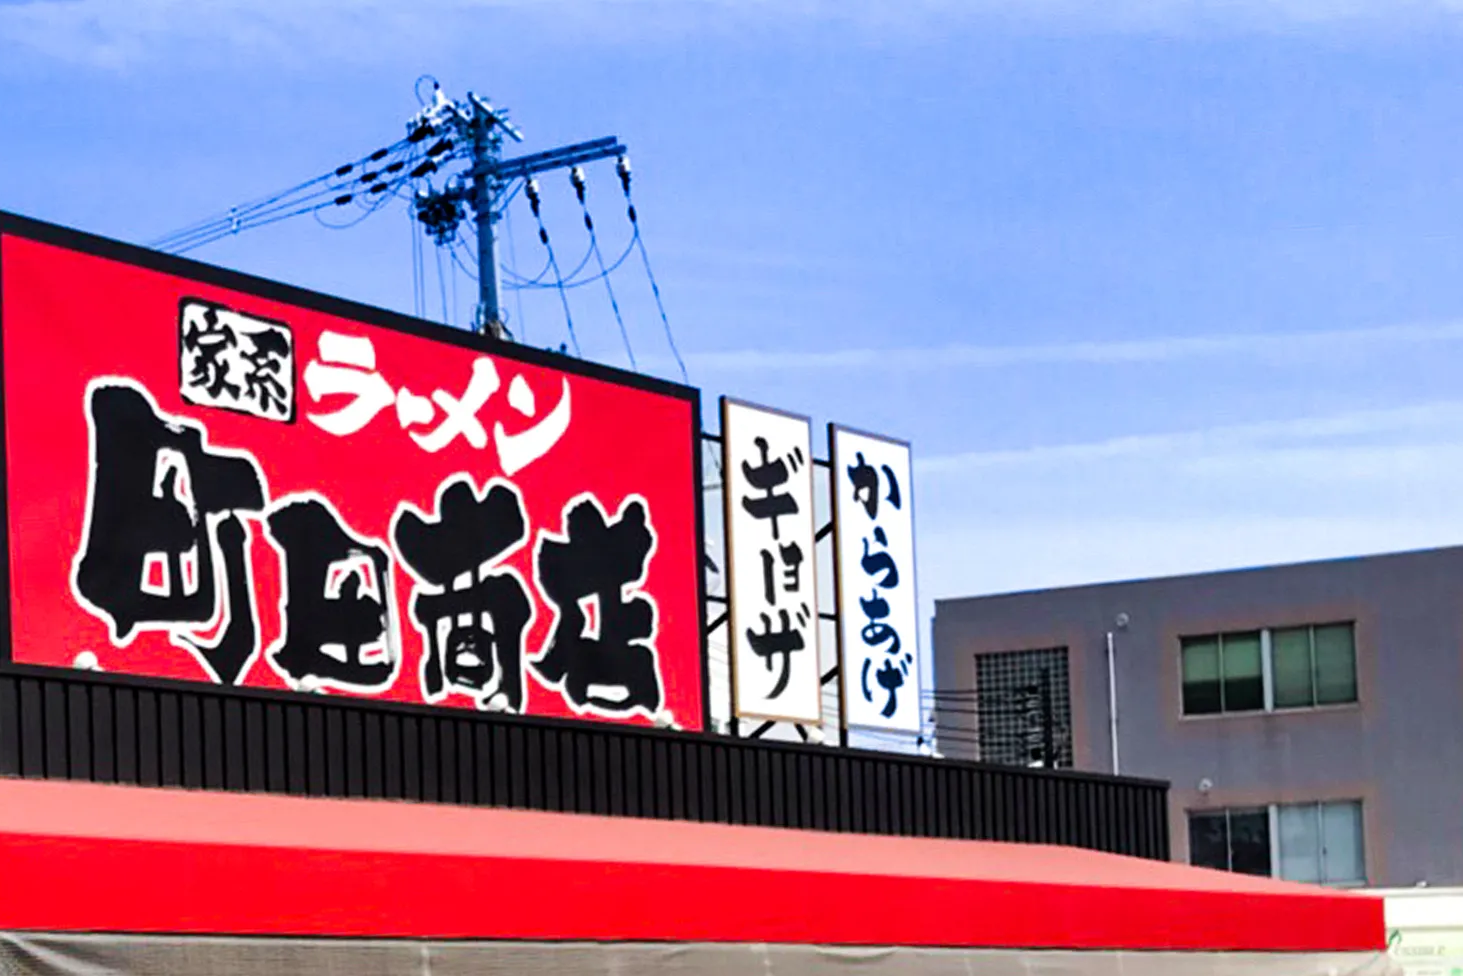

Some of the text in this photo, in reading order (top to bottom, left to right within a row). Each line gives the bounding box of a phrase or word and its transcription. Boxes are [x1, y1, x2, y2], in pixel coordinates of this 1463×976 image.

[71, 377, 676, 718] 町田商店
[740, 436, 811, 700] ギョーザ
[847, 451, 913, 718] からあげ
